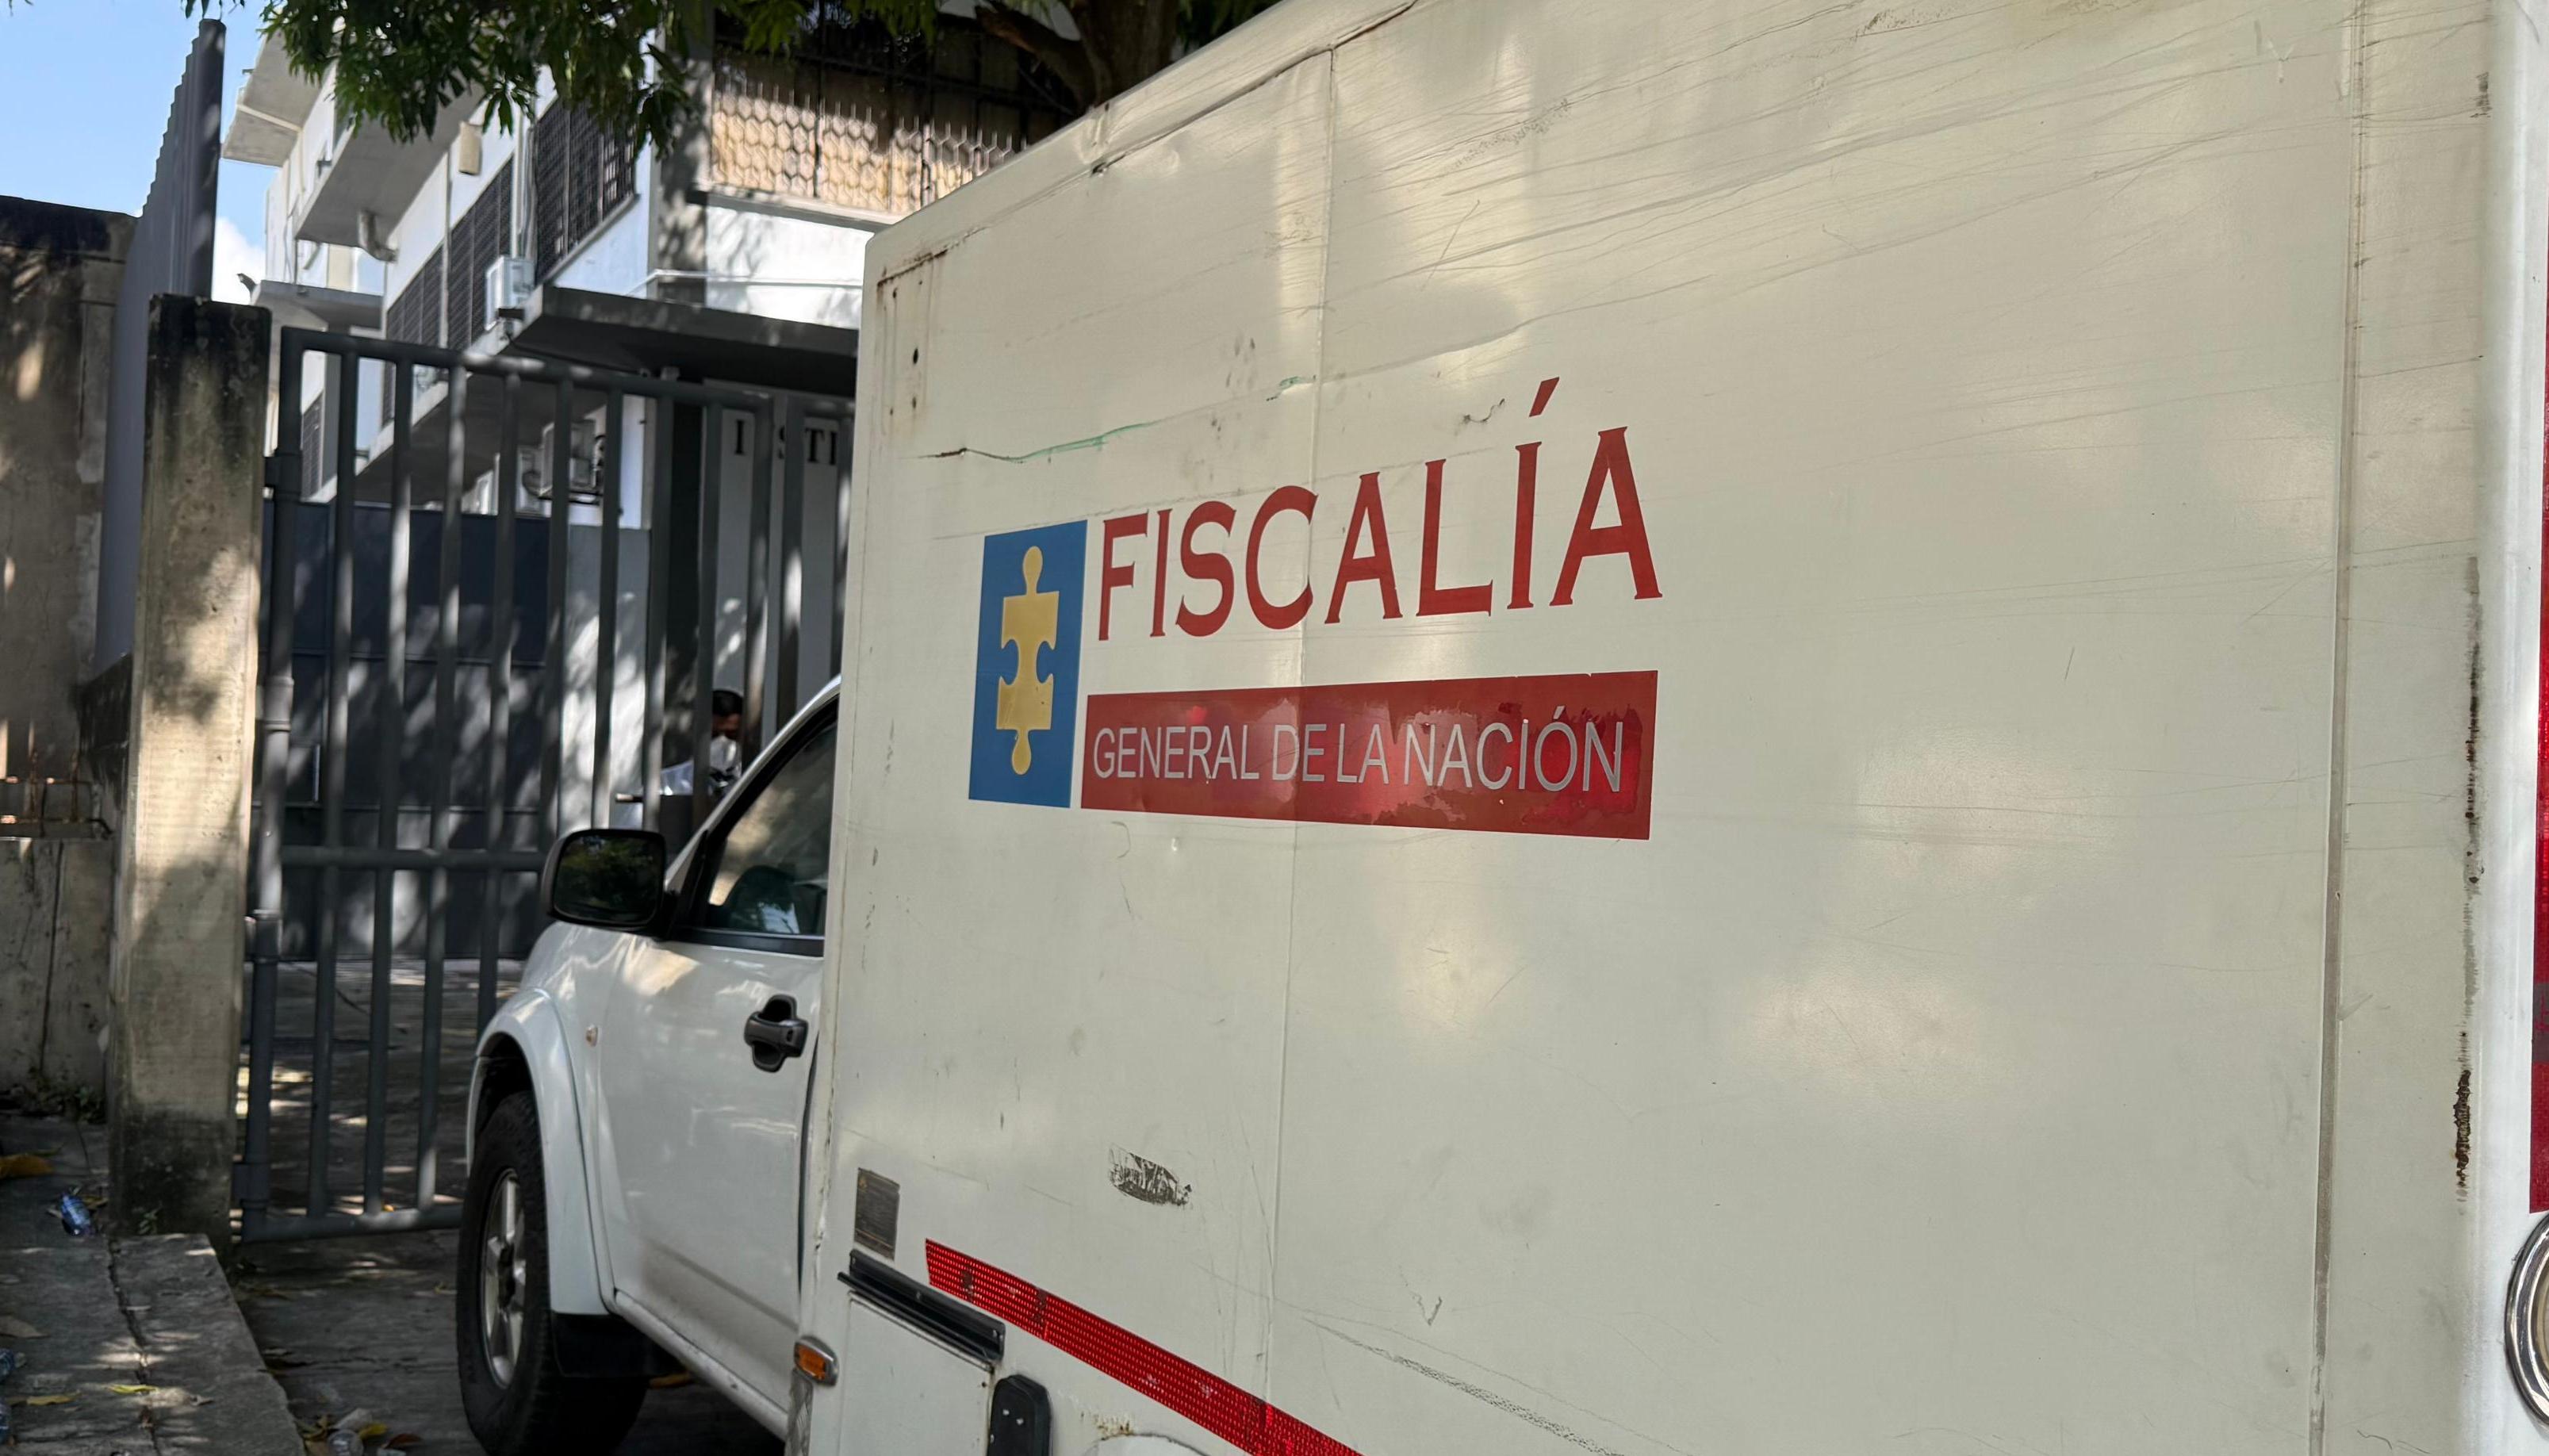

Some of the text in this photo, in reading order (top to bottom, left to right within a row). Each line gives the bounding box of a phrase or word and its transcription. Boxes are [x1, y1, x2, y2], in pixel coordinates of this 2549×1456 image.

[1098, 377, 1663, 641] FISCALÍA
[1093, 705, 1624, 792] GENERAL DE LA NACIÓN
